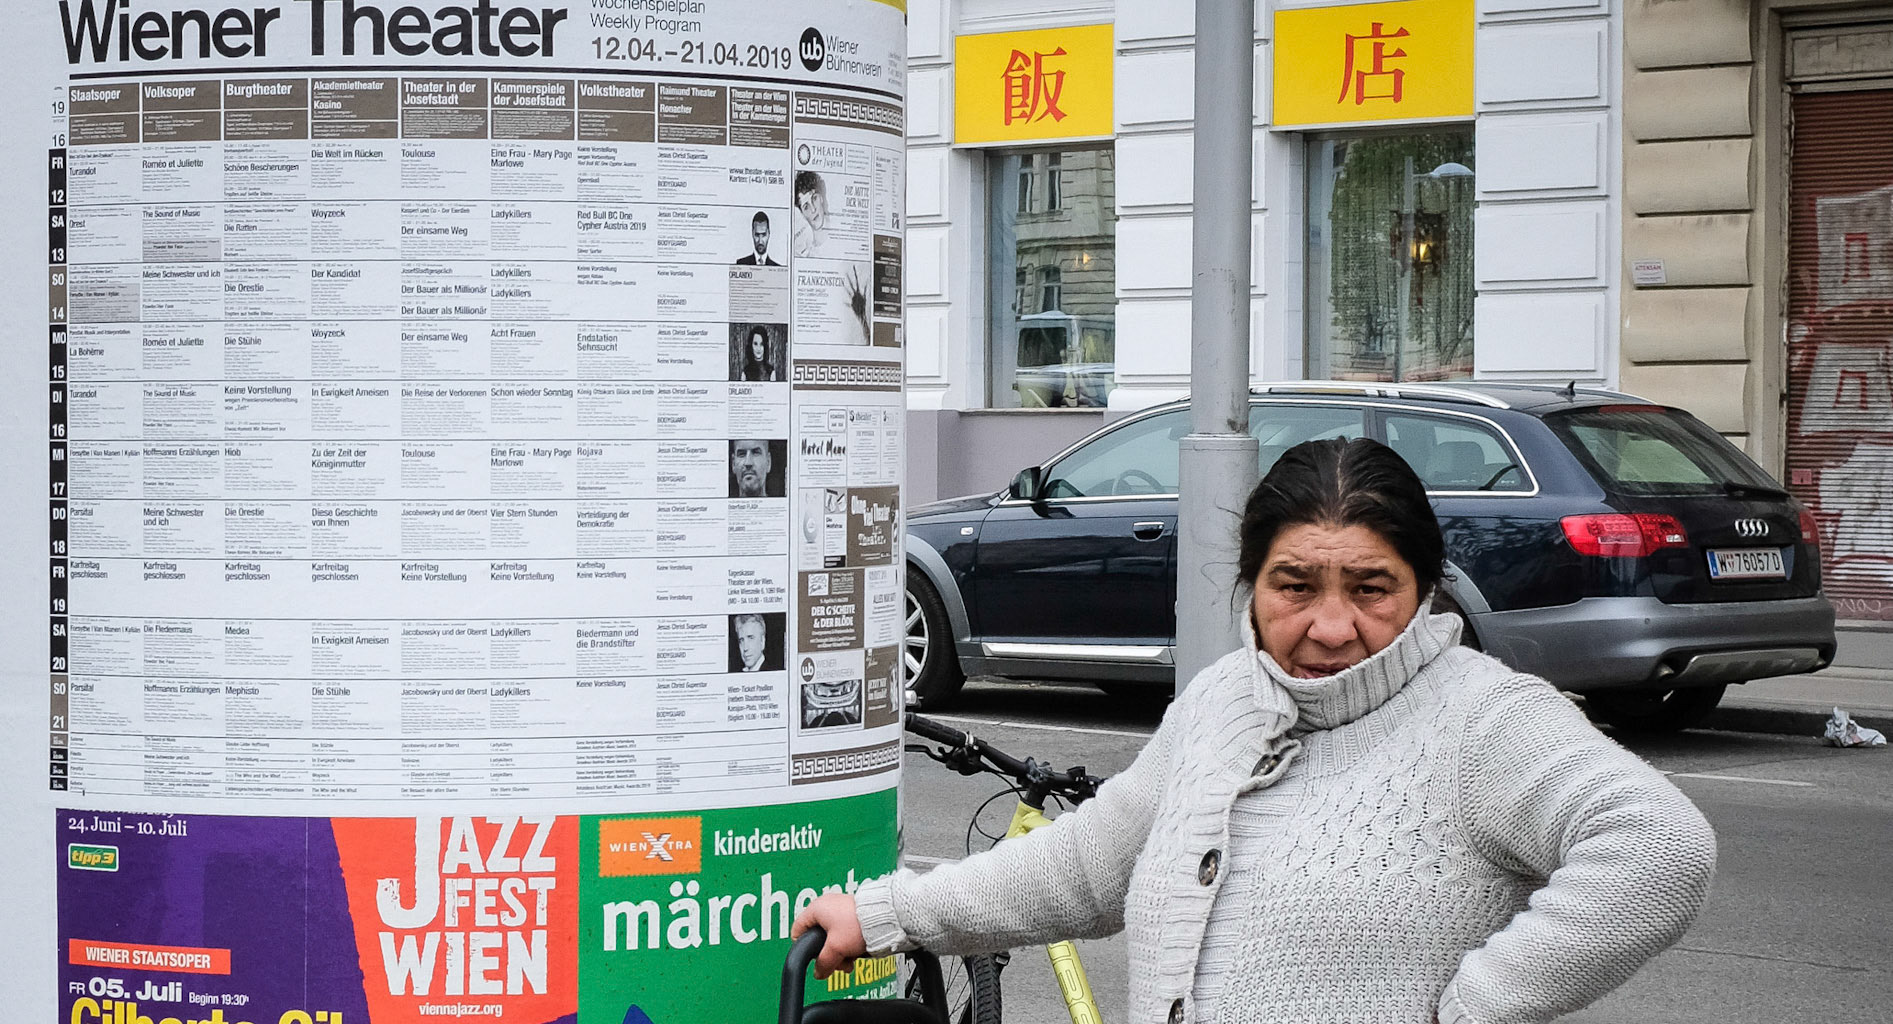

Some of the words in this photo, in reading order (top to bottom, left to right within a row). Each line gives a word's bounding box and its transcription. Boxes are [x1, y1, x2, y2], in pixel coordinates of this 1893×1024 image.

[590, 13, 640, 32] Weekly
[645, 15, 701, 34] Program
[59, 0, 280, 64] Wiener
[294, 0, 567, 57] Theater
[826, 36, 859, 55] Wiener
[826, 55, 882, 78] Bühnenverein
[1337, 21, 1410, 105] 店
[144, 86, 196, 99] Volksoper
[227, 83, 293, 98] Burgtheater
[313, 81, 384, 91] Akademietheater
[404, 82, 444, 93] Theater
[447, 82, 457, 93] in
[460, 82, 476, 93] der
[493, 82, 566, 95] Kammerspiele
[580, 84, 645, 98] Volkstheater
[660, 86, 690, 96] Raimund
[691, 87, 716, 98] Theater
[1001, 46, 1067, 126] 飯
[70, 89, 121, 103] Staatsoper
[404, 93, 458, 105] Josefstadt
[493, 95, 510, 106] der
[513, 95, 566, 107] Josefstadt
[52, 102, 65, 115] 19
[313, 100, 341, 110] Kasino
[52, 134, 65, 147] 16
[311, 149, 323, 158] Die
[325, 149, 341, 158] Welt
[354, 149, 383, 158] Rücken
[401, 149, 435, 158] Toulouse
[812, 146, 843, 157] THEATER
[52, 157, 64, 169] FR
[51, 190, 64, 203] 12
[311, 209, 345, 219] Woyzeck
[491, 210, 532, 219] Ladykillers
[52, 215, 64, 227] SA
[401, 227, 414, 235] Der
[451, 227, 468, 237] Weg
[51, 248, 64, 261] 13
[52, 274, 64, 286] SO
[51, 307, 64, 320] 14
[52, 332, 66, 344] MO
[491, 329, 507, 338] Acht
[510, 329, 536, 338] Frauen
[577, 333, 618, 342] Endstation
[51, 365, 65, 378] 15
[53, 391, 62, 403] DI
[491, 388, 514, 397] Schon
[516, 388, 541, 397] wieder
[543, 388, 573, 398] Sonntag
[51, 424, 65, 437] 16
[52, 449, 64, 461] MI
[577, 447, 603, 457] Rojava
[52, 482, 65, 495] 17
[53, 507, 66, 520] DO
[490, 509, 504, 517] Vier
[506, 509, 526, 517] Stern
[528, 509, 558, 517] Stunden
[52, 541, 65, 554] 18
[53, 566, 65, 579] FR
[225, 563, 261, 572] Karfreitag
[225, 572, 270, 581] geschlossen
[53, 599, 65, 612] 19
[53, 624, 66, 637] SA
[576, 629, 621, 638] Biedermann
[623, 628, 639, 637] und
[576, 639, 588, 648] die
[590, 639, 635, 648] Brandstifter
[53, 657, 65, 670] 20
[53, 682, 66, 695] SO
[225, 686, 259, 696] Mephisto
[52, 715, 65, 729] 21
[68, 818, 89, 832] 24.
[91, 817, 121, 833] Juni
[137, 822, 156, 835] 10.
[158, 820, 187, 837] Juli
[714, 824, 823, 856] kinderaktiv
[71, 850, 115, 867] tipp3
[376, 816, 556, 928] JAZZ
[445, 877, 556, 927] FEST
[85, 946, 130, 964] WIENER
[132, 951, 211, 969] STAATSOPER
[378, 930, 547, 995] WIEN
[69, 981, 86, 995] FR
[89, 977, 131, 998] 05.
[136, 980, 182, 1002] Juli
[188, 992, 219, 1006] Beginn
[419, 1001, 503, 1017] viennajazz.org
